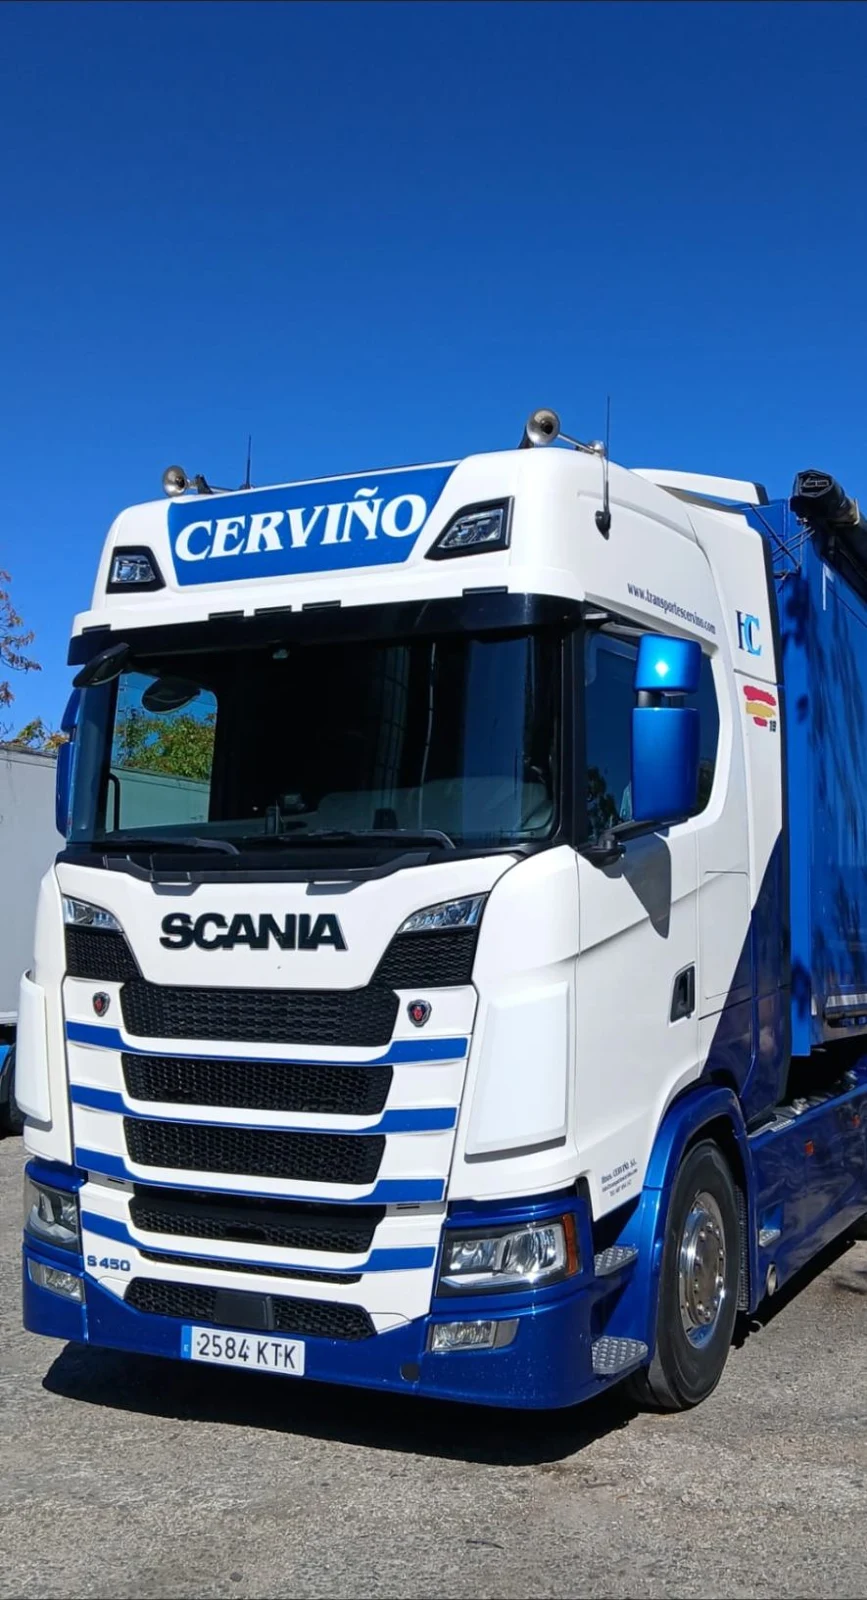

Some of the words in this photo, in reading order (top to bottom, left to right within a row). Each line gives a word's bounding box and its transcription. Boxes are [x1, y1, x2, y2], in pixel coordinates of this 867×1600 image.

[174, 486, 427, 562] CERVIÑO
[159, 912, 348, 951] SCANIA
[87, 1254, 97, 1267] S
[99, 1257, 131, 1272] 450
[199, 1332, 250, 1362] 2584
[256, 1341, 296, 1370] KTK
